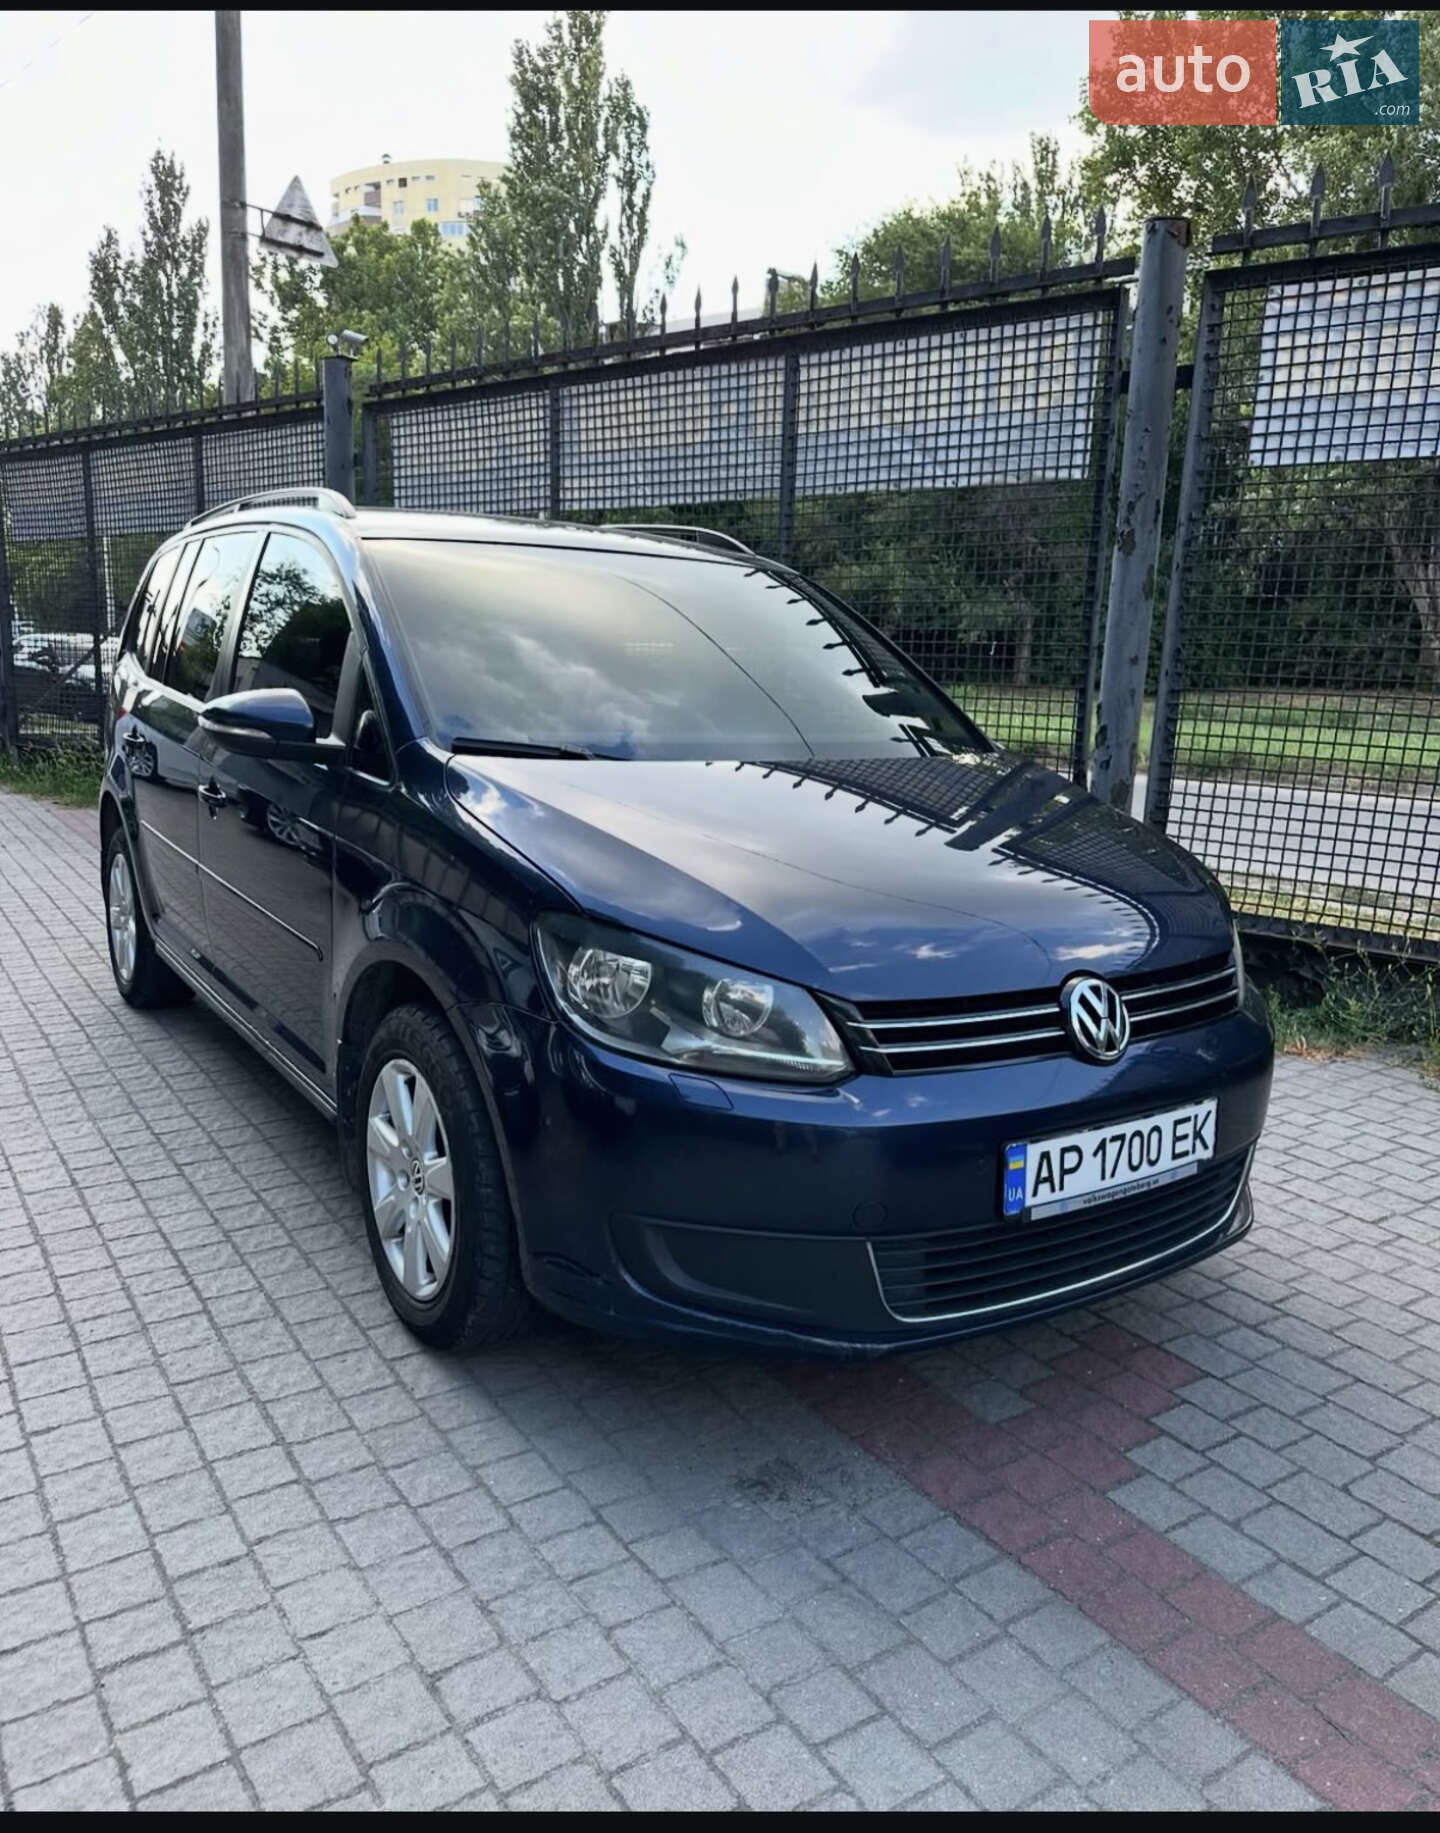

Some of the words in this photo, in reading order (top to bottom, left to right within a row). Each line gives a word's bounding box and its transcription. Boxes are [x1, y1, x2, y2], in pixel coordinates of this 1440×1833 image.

[1031, 1144, 1084, 1198] AP
[1092, 1124, 1163, 1181] 1700
[1171, 1109, 1212, 1161] EK
[1008, 1186, 1024, 1202] UA
